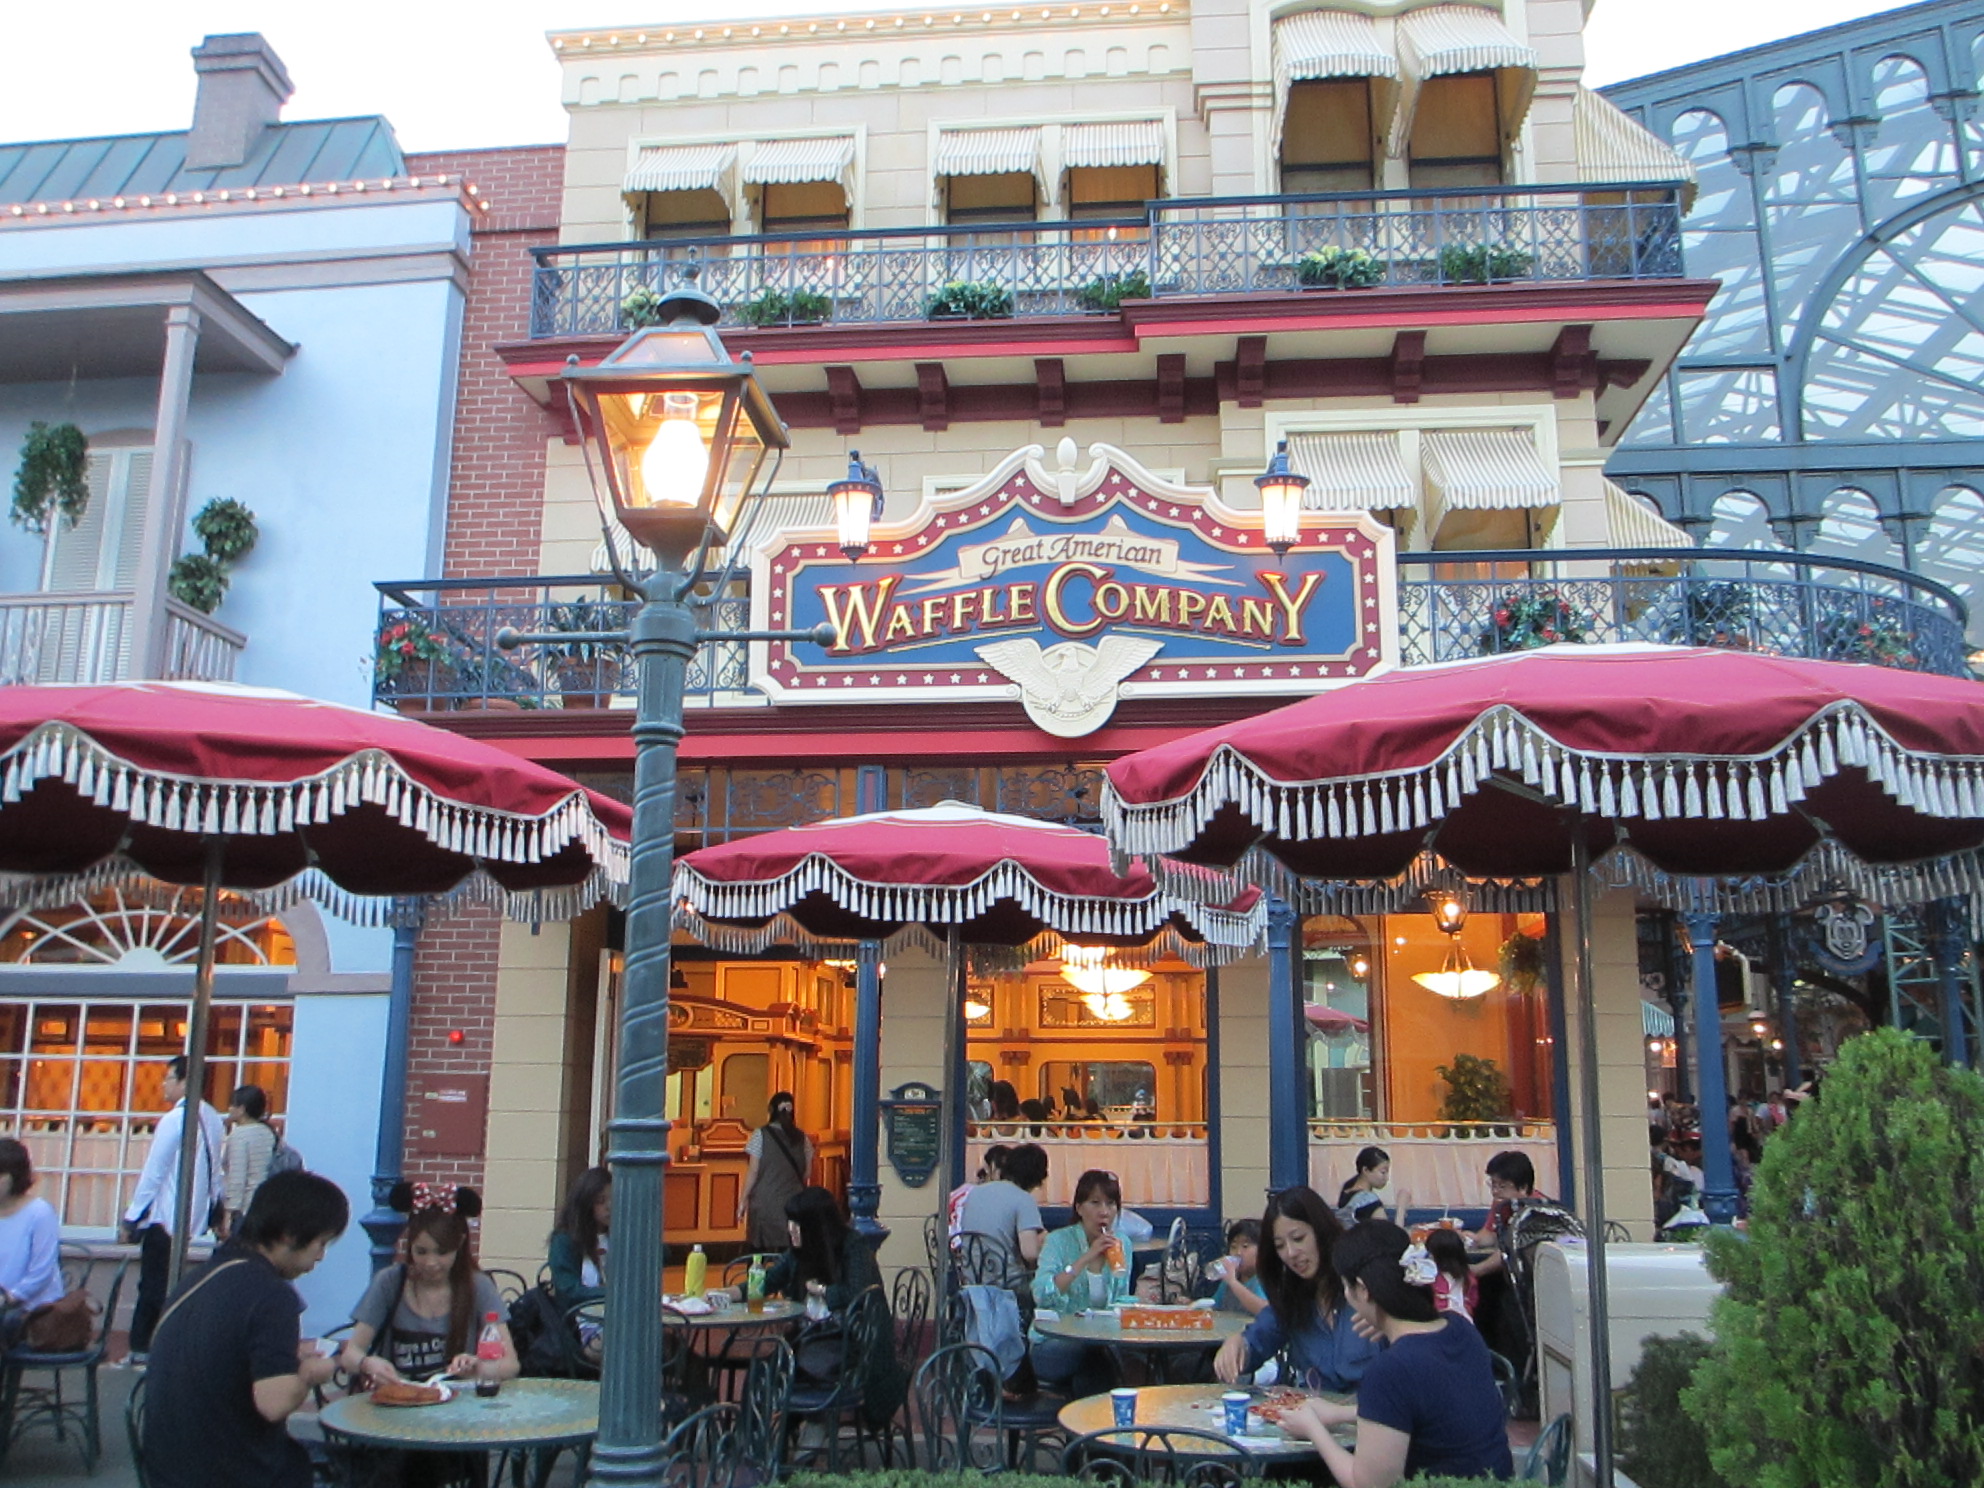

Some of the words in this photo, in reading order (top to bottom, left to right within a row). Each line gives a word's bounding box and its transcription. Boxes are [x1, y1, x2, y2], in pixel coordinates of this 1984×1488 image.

[980, 541, 1044, 580] Great
[1047, 534, 1162, 565] American
[817, 574, 1037, 653] WAFFLE
[1044, 562, 1323, 643] COMPANY
